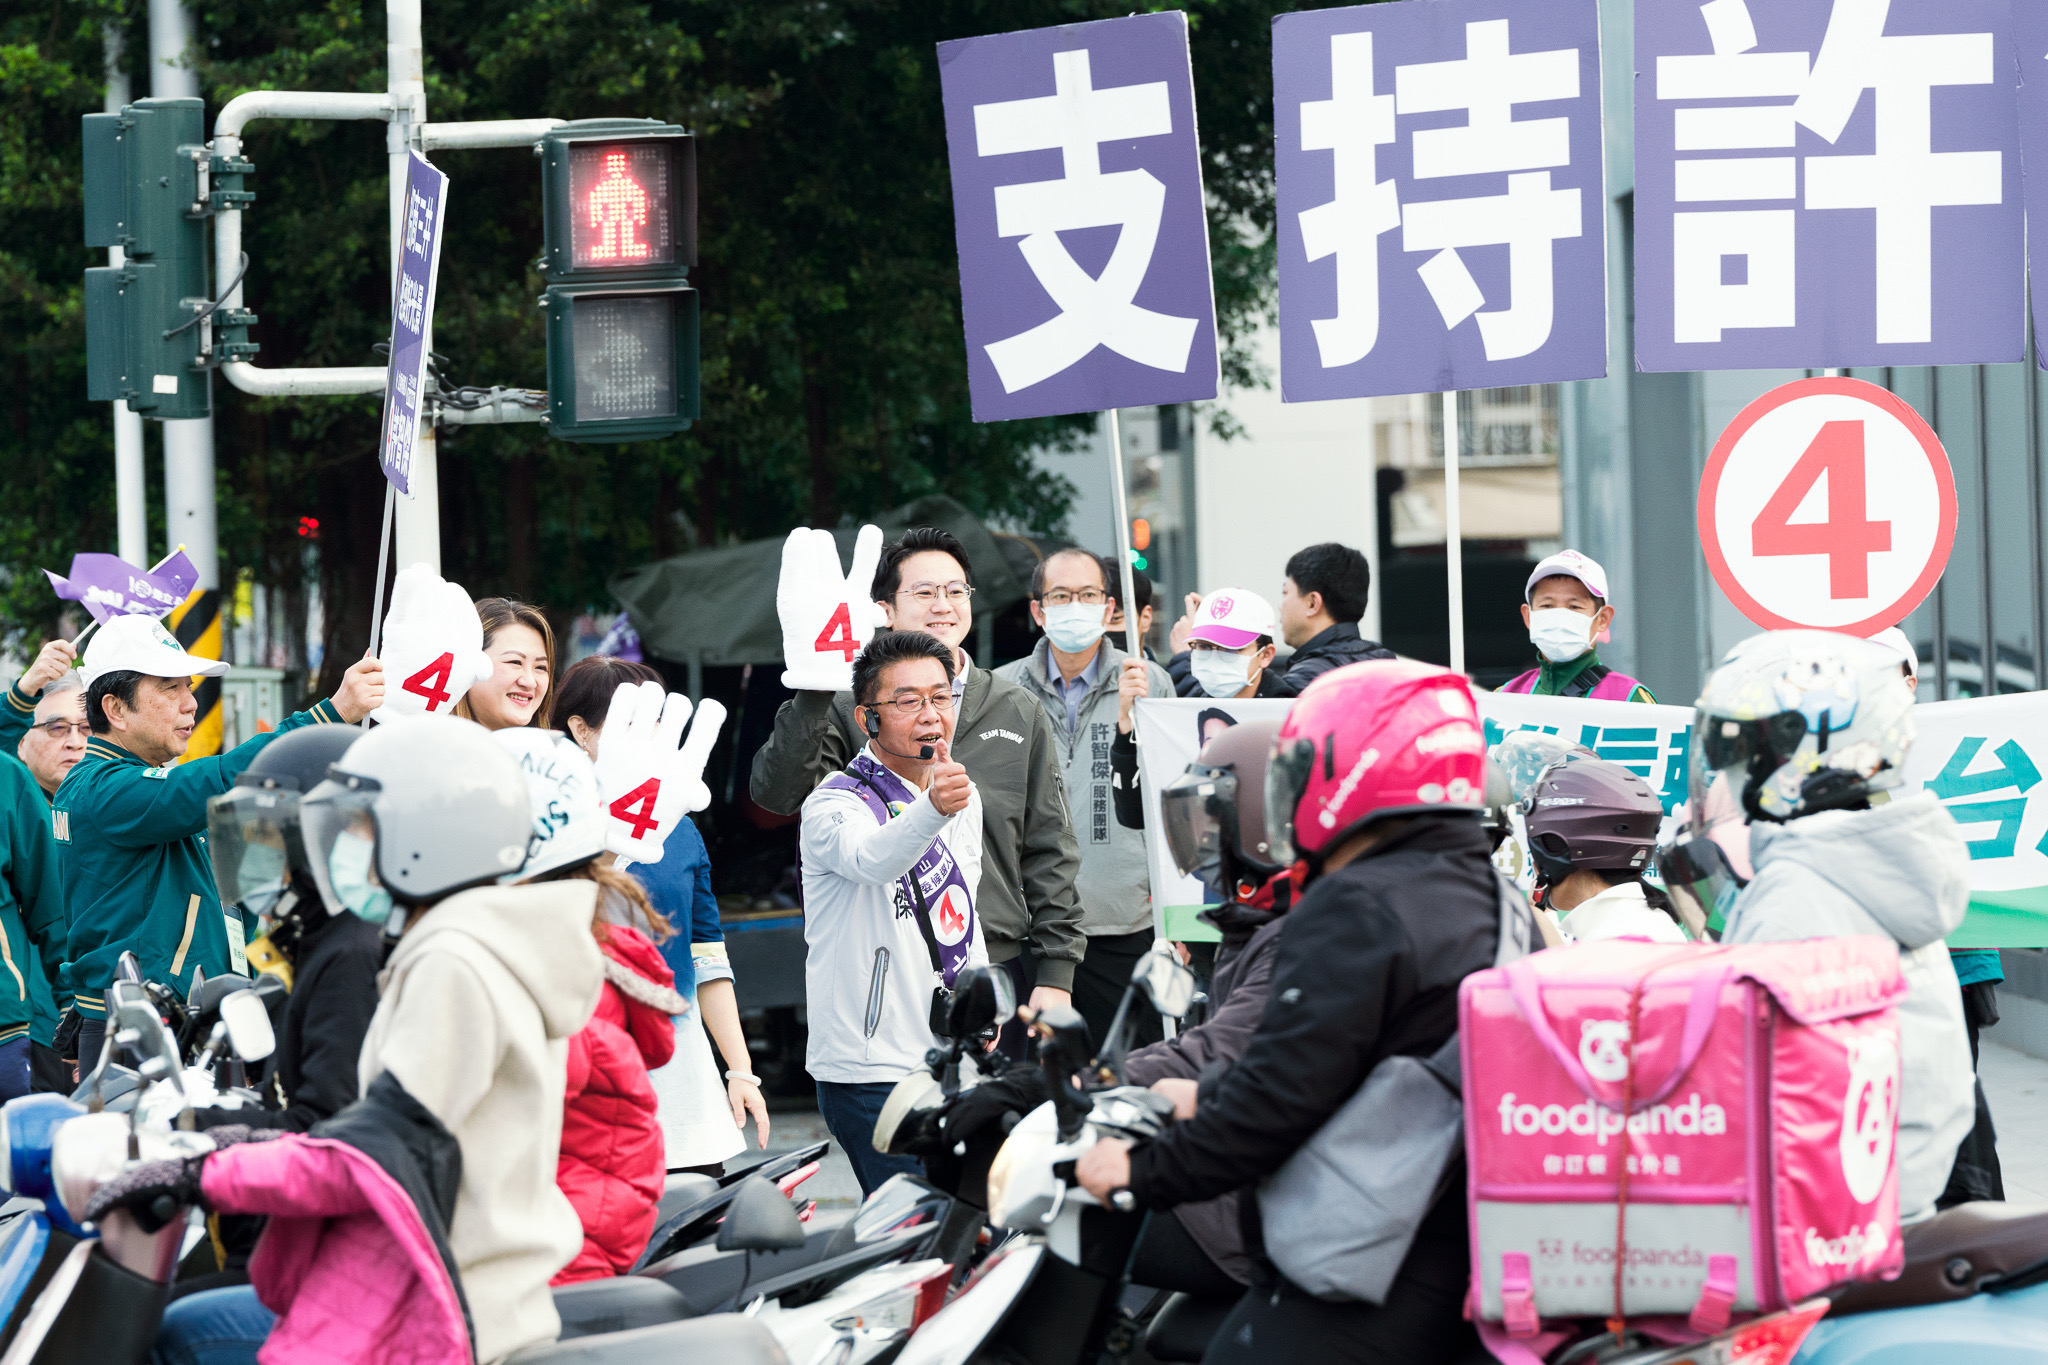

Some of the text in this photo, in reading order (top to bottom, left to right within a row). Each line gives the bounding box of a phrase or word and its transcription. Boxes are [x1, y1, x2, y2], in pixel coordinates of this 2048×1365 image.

[1299, 19, 1583, 369] 持
[1656, 0, 2002, 344] 許
[973, 48, 1200, 394] 支
[1751, 420, 1891, 600] 4
[815, 603, 861, 662] 4
[402, 651, 454, 712] 4
[979, 729, 1025, 744] TEAM TAIWAN
[1091, 722, 1109, 779] 許智傑
[609, 777, 661, 840] 4
[1093, 785, 1107, 840] 服務團隊
[939, 888, 965, 937] 4
[1498, 1092, 1727, 1147] foodpanda
